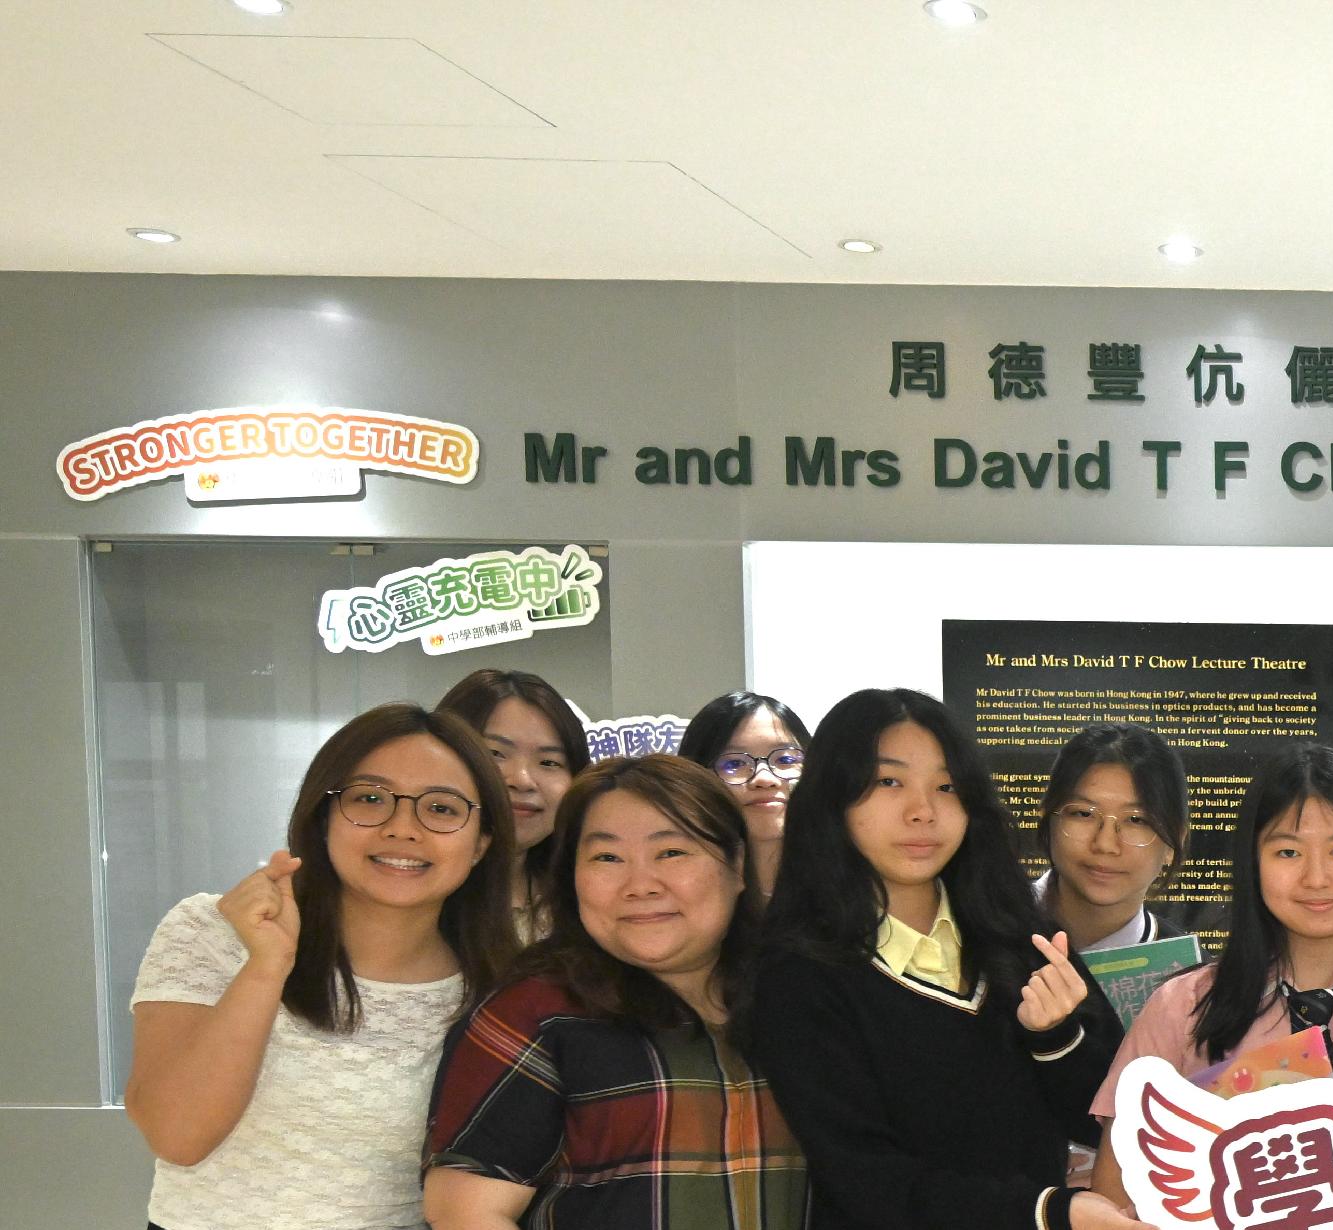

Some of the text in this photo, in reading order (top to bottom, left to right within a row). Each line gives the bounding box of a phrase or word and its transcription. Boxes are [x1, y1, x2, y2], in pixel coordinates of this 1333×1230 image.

[70, 420, 465, 487] STRONGER TOGETHER
[524, 432, 607, 485] Mr
[634, 435, 752, 487] and
[785, 436, 901, 488] Mrs
[934, 438, 1111, 491] David
[1143, 440, 1181, 491] T
[1214, 441, 1248, 491] F
[353, 560, 556, 638] 心靈充電中
[447, 619, 523, 643] 中學部輔導組
[986, 653, 1307, 670] Mr and Mrs David T F Chow Lecture Theatre
[976, 688, 988, 697] Mr
[990, 688, 1015, 697] David
[1017, 688, 1022, 697] T
[1024, 688, 1030, 697] F
[1032, 688, 1056, 698] Chow
[1057, 690, 1074, 698] was
[1075, 689, 1095, 698] born
[1096, 690, 1105, 698] in
[1106, 690, 1129, 699] Hong
[1130, 690, 1152, 700] Kong
[1164, 691, 1188, 700] 1947,
[1189, 691, 1216, 699] where
[1216, 691, 1227, 699] he
[1228, 692, 1249, 701] grew
[1251, 693, 1262, 701] up
[1263, 692, 1279, 700] and
[1280, 692, 1317, 700] received
[976, 700, 990, 708] his
[992, 700, 1040, 709] education.
[1043, 701, 1055, 709] He
[1057, 701, 1091, 709] started
[1093, 701, 1107, 709] his
[1108, 702, 1149, 710] business
[1151, 702, 1160, 710] in
[1162, 703, 1191, 711] optics
[1192, 702, 1236, 712] products,
[1238, 703, 1255, 711] and
[1257, 703, 1273, 711] has
[1274, 703, 1309, 712] become
[976, 713, 1021, 722] prominent
[1023, 713, 1062, 721] business
[1063, 713, 1091, 721] leader
[1093, 713, 1102, 721] in
[1103, 714, 1126, 723] Hong
[1128, 714, 1152, 723] Kong.
[1155, 714, 1164, 722] In
[1166, 714, 1180, 722] the
[1181, 714, 1206, 724] spirit
[1208, 714, 1217, 722] of
[1252, 715, 1273, 723] back
[1274, 716, 1284, 724] to
[1285, 715, 1317, 725] society
[1006, 725, 1032, 733] takes
[1033, 725, 1055, 733] from
[1056, 725, 1083, 734] societ
[1157, 726, 1178, 734] been
[1187, 727, 1221, 735] fervent
[1222, 727, 1249, 735] donor
[1272, 727, 1287, 735] the
[1289, 729, 1318, 737] years,
[977, 737, 1229, 748] supporting medical in Hong Kong.
[1009, 773, 1032, 783] great
[1202, 775, 1253, 784] mountainou
[1197, 787, 1211, 795] the
[1213, 787, 1246, 796] unbrid
[1010, 797, 1022, 805] Mr
[1023, 797, 1041, 805] Cho
[1205, 799, 1229, 807] build
[1215, 812, 1238, 820] annu
[1215, 822, 1224, 831] of
[1206, 859, 1233, 867] tertia
[1197, 882, 1222, 890] made
[1186, 894, 1223, 902] research
